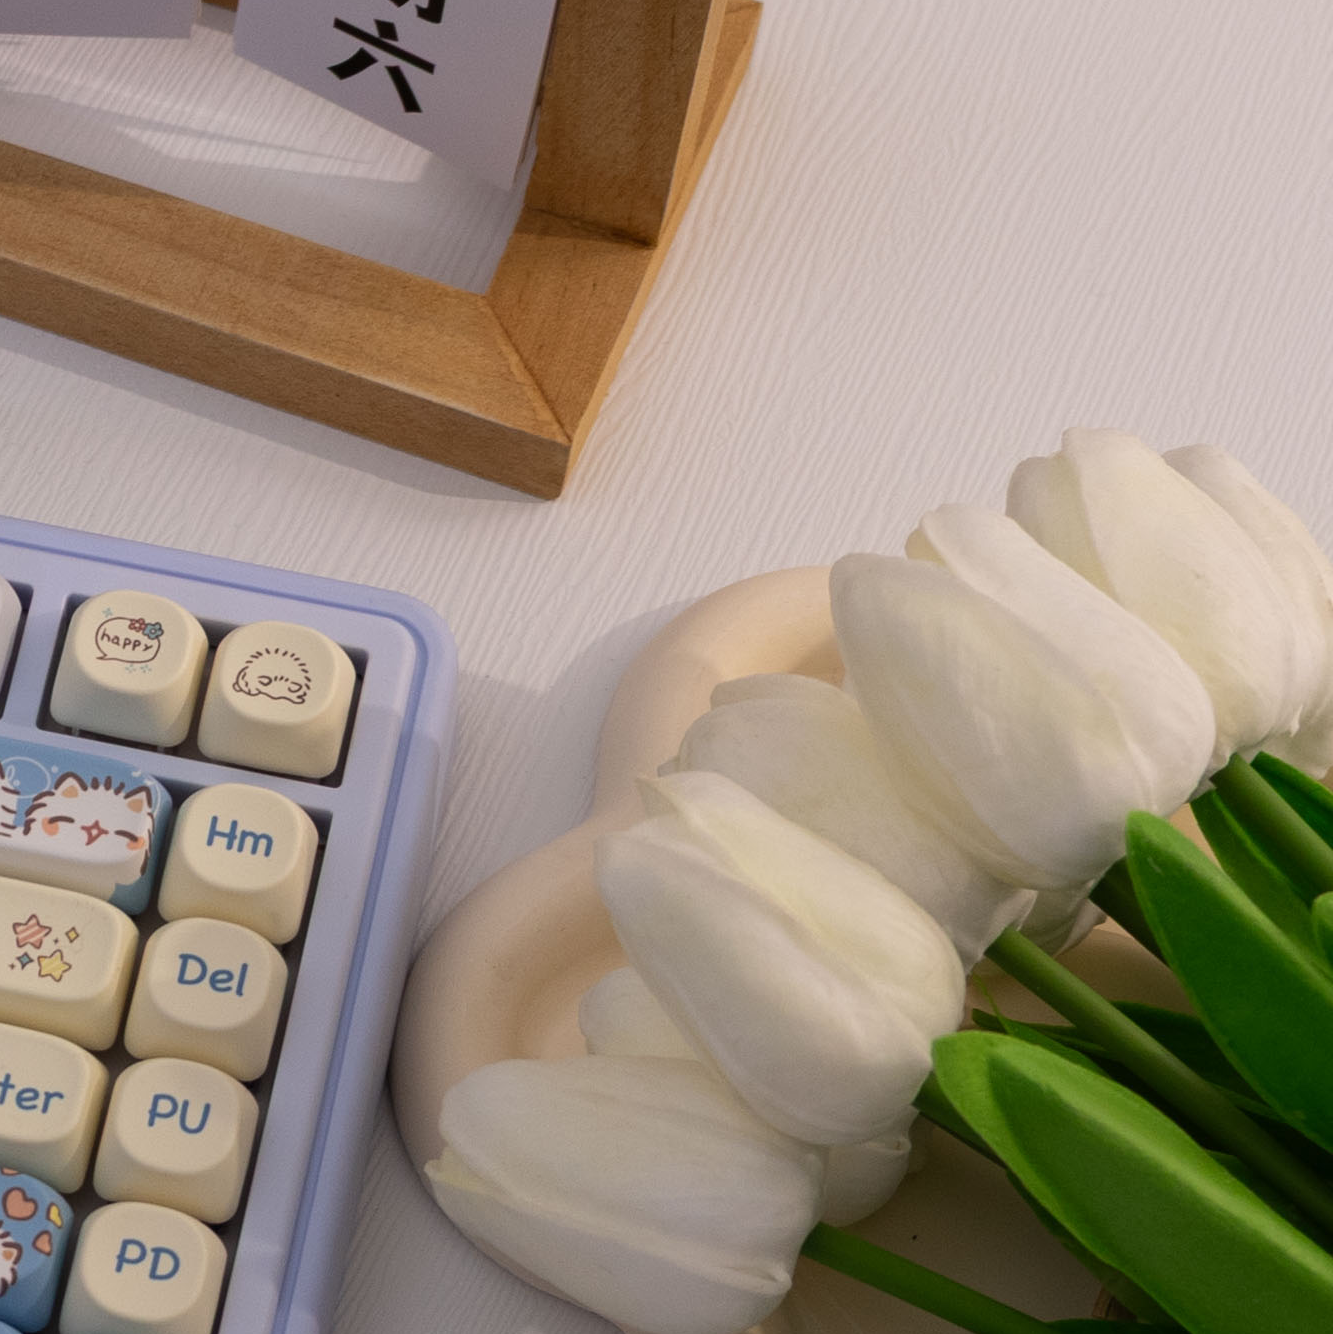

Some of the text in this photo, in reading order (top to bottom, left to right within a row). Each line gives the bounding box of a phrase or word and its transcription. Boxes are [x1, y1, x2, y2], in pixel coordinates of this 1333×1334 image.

[100, 628, 153, 651] happy
[206, 815, 274, 858] Hm
[177, 953, 249, 997] Del
[147, 1093, 211, 1135] PU
[115, 1238, 181, 1281] PD
